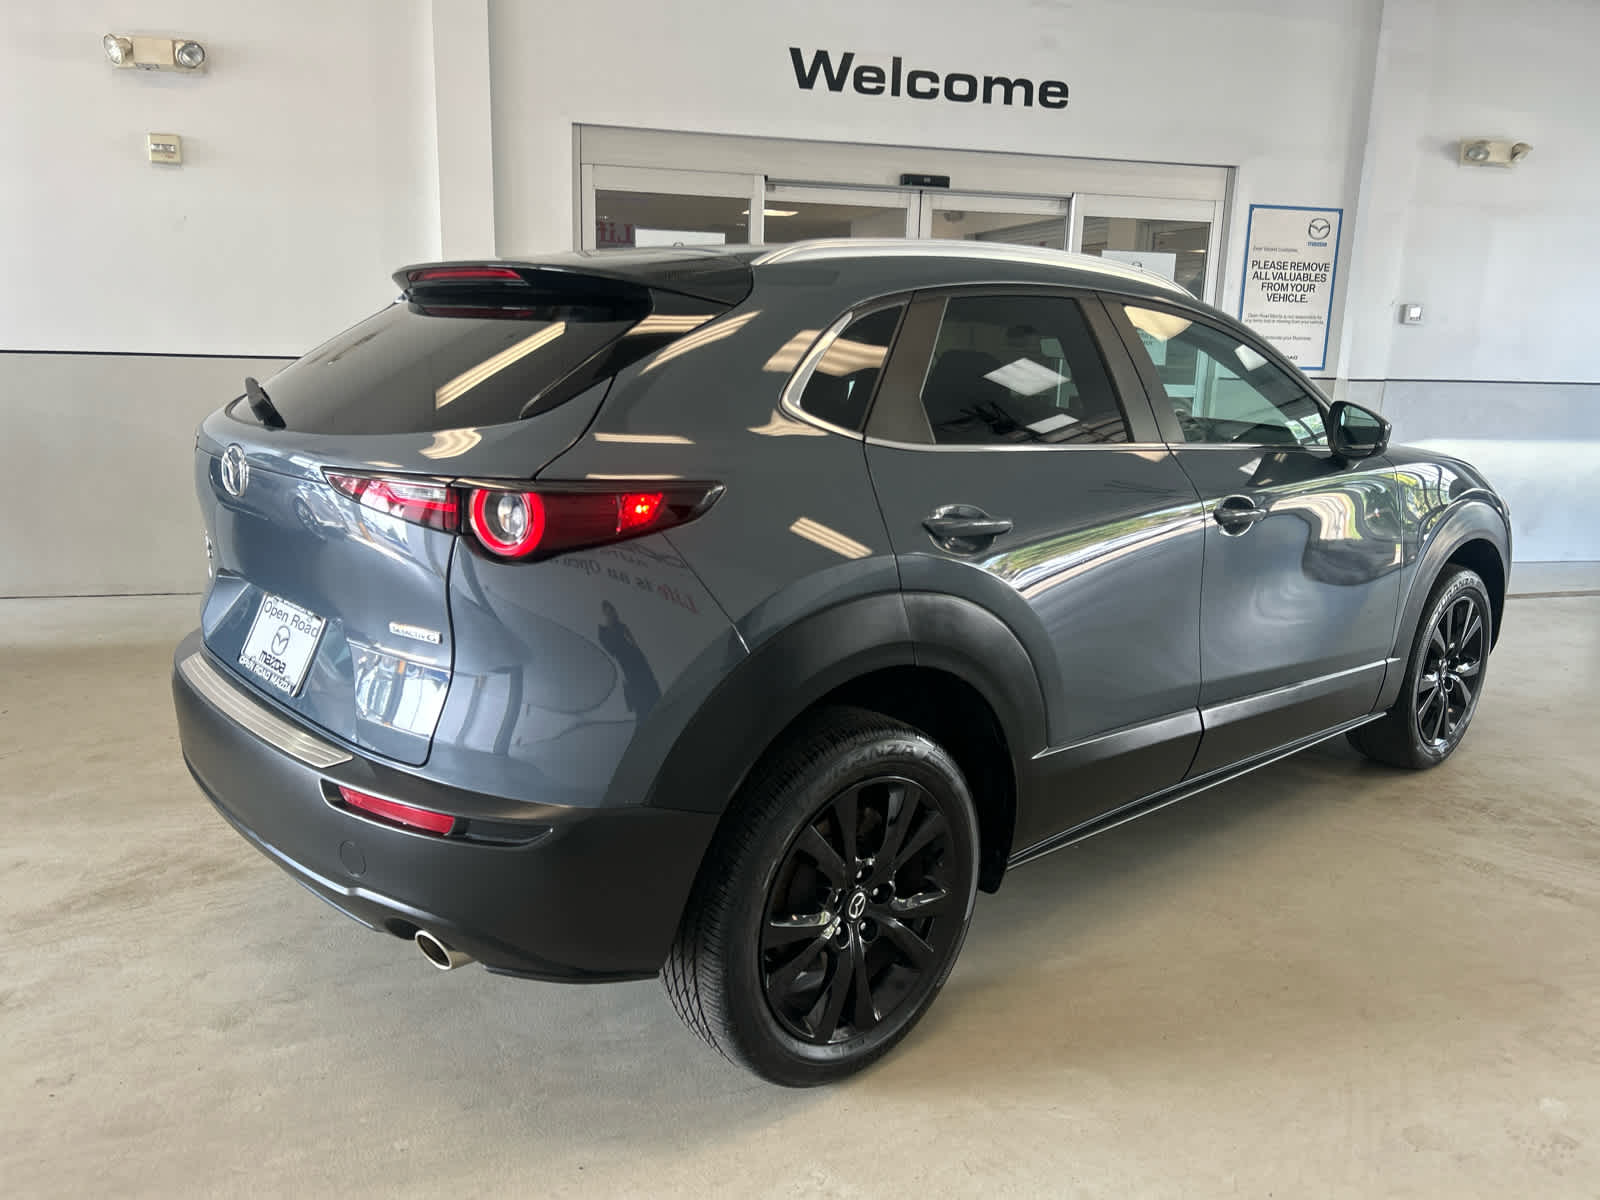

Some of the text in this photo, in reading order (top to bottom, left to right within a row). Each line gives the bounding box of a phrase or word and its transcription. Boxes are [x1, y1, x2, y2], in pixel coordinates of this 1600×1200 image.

[789, 47, 1069, 109] Welcome
[1251, 259, 1330, 272] PLEASE REMOVE
[1252, 270, 1327, 283] ALL VALUABLES
[1261, 281, 1316, 293] FROM YOUR
[1266, 292, 1309, 304] VEHICLE.
[264, 600, 319, 638] Open Road
[260, 650, 287, 674] mazda
